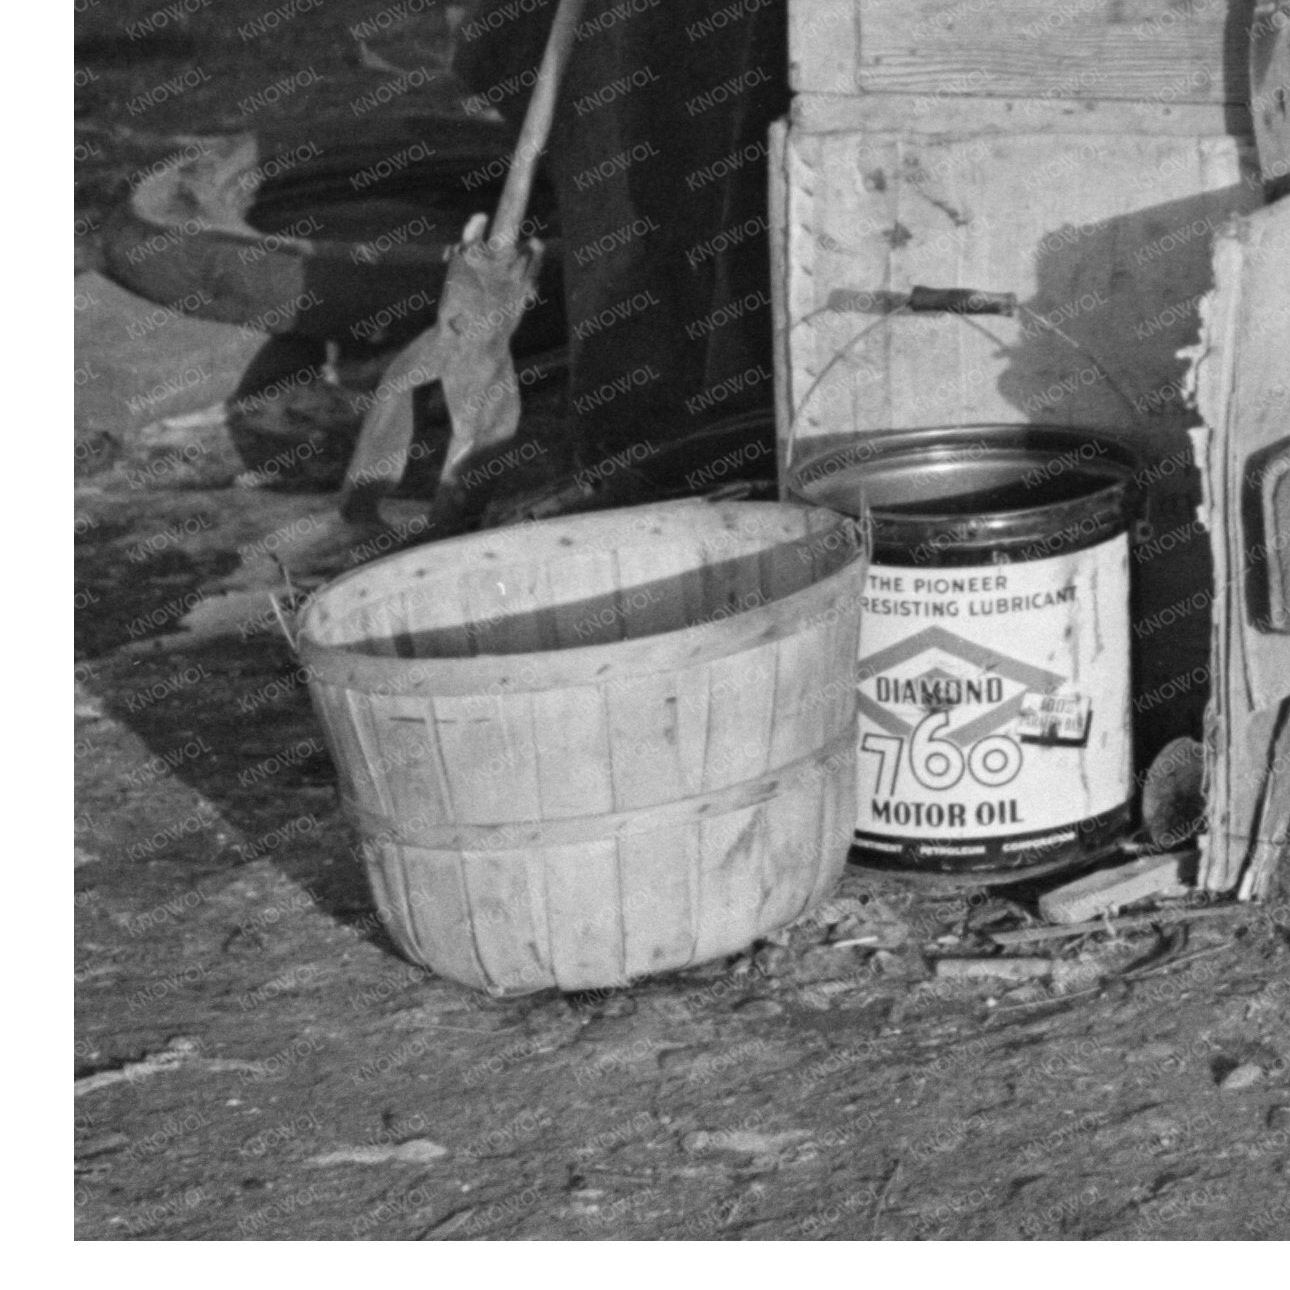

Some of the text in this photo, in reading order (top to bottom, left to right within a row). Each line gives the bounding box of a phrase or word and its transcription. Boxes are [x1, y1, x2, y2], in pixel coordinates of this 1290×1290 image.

[869, 574, 1008, 594] THE PIONEER
[969, 585, 1078, 617] LUBRICANT
[875, 676, 1003, 706] DIAMOND
[861, 711, 1024, 797] 760
[871, 798, 1025, 828] MOTOR OIL
